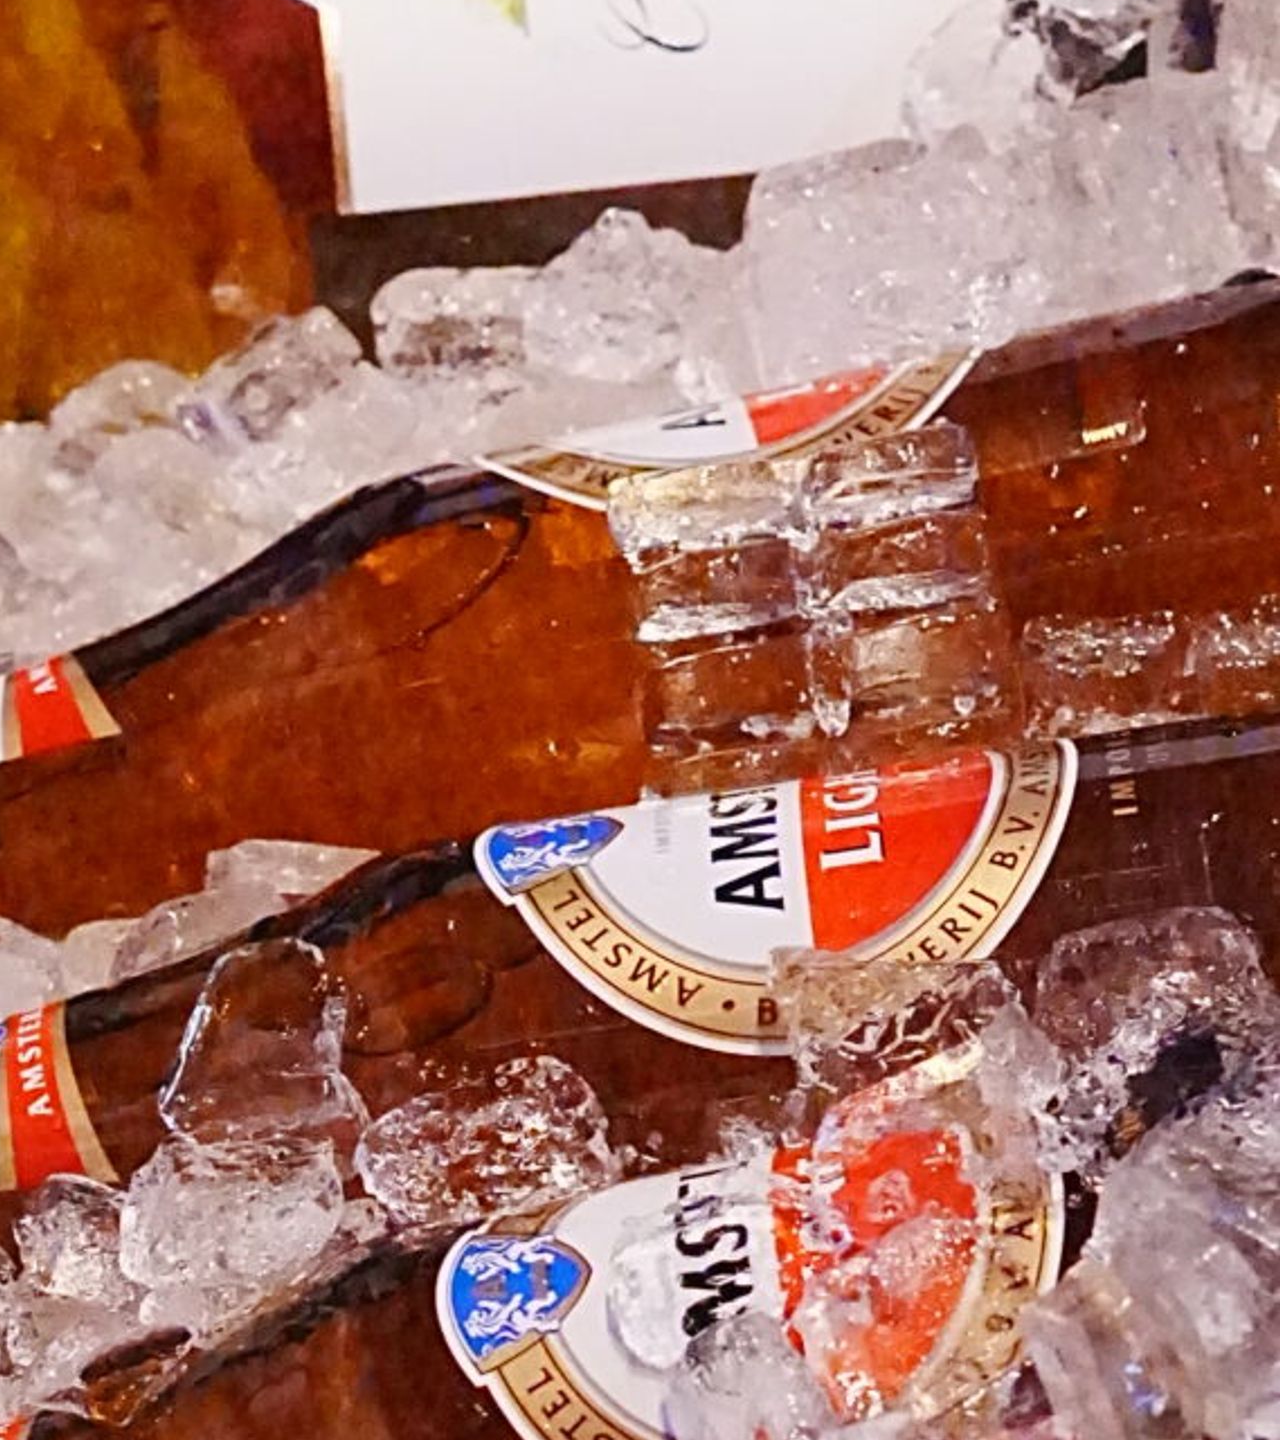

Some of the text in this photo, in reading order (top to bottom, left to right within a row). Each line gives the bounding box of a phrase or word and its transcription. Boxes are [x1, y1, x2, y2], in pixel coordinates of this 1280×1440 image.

[553, 888, 704, 1007] AMSTEL
[988, 811, 1041, 871] B.V.
[709, 786, 785, 911] AMS
